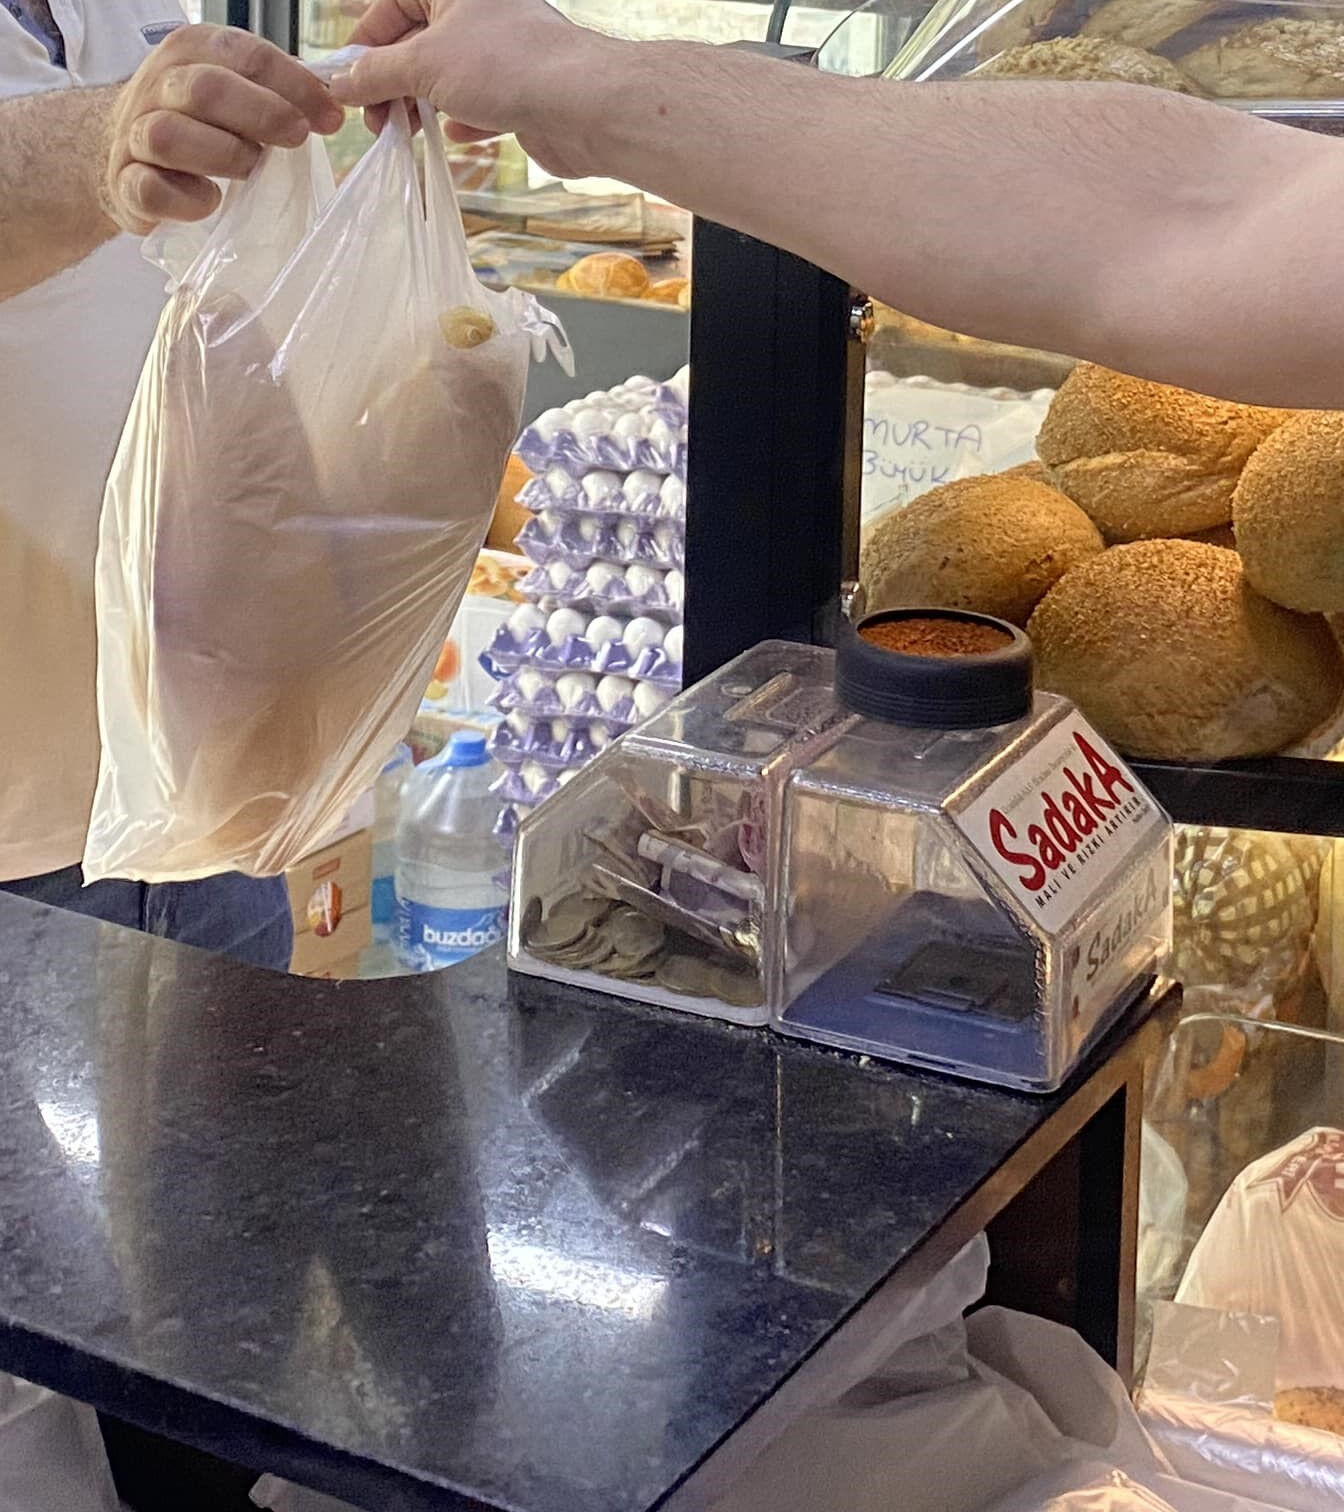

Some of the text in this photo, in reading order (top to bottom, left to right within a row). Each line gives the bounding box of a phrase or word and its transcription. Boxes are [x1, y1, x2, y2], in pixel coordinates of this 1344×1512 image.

[1035, 881, 1062, 910] MALI
[1061, 859, 1078, 881] VE
[1077, 833, 1105, 862] RIZKI
[1105, 794, 1143, 836] ARTIRIR
